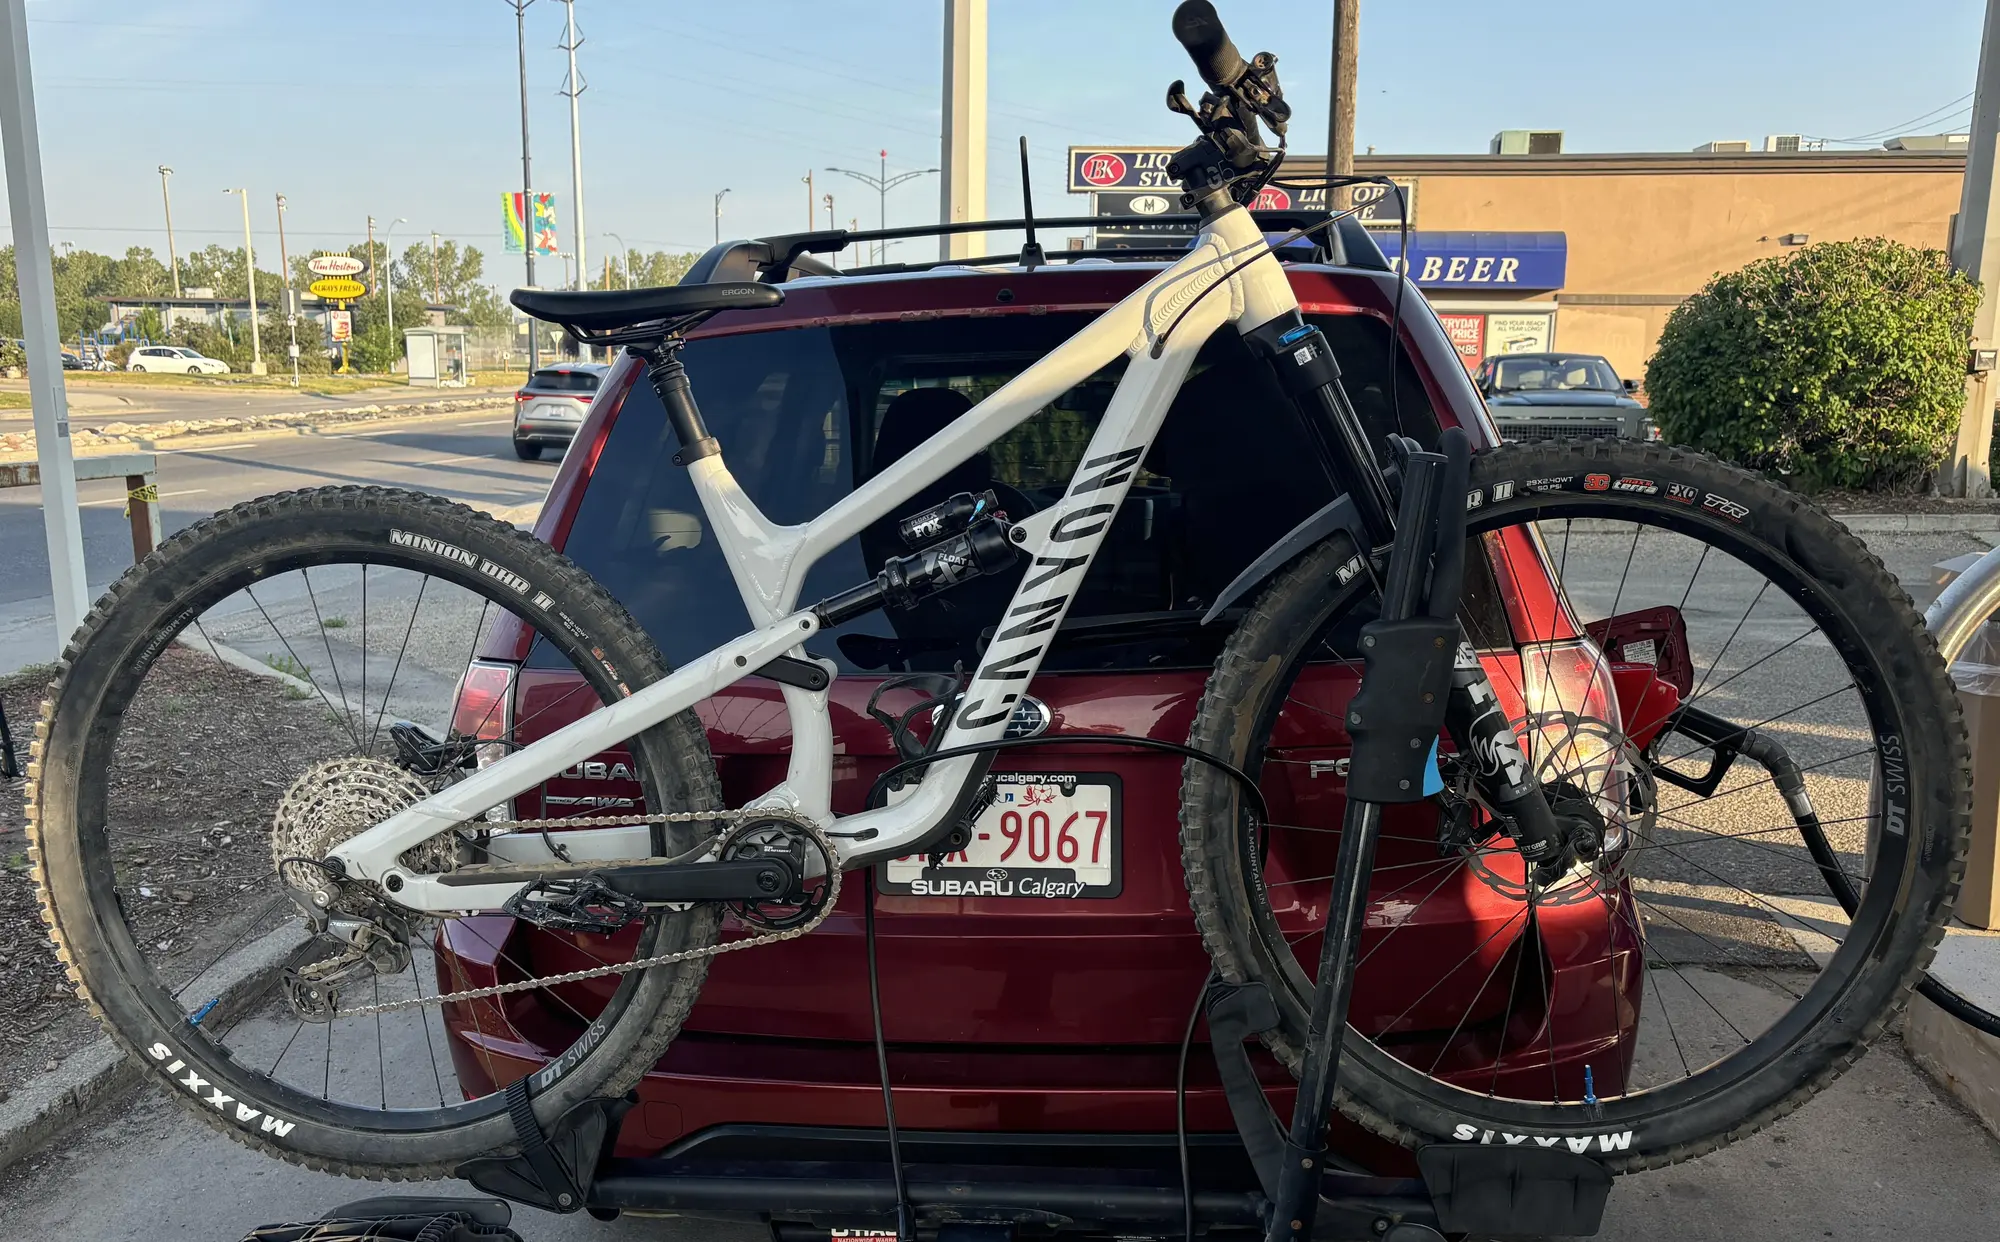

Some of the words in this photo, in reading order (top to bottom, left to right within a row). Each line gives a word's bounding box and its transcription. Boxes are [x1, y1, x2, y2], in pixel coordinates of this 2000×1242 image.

[1087, 157, 1117, 180] BK
[1133, 154, 1171, 171] LIQ
[1138, 172, 1181, 187] STO
[1298, 188, 1385, 202] LIOR
[312, 260, 328, 270] Tim
[329, 259, 360, 271] Hortons
[1418, 257, 1519, 283] BEER
[340, 284, 361, 292] FRESH
[721, 288, 755, 296] ERGON
[1441, 318, 1480, 329] ERYDAY
[1451, 328, 1479, 339] PRICE
[1526, 476, 1574, 487] 29X2.40WT
[1584, 473, 1611, 491] 3C
[1612, 480, 1658, 495] terra
[1492, 480, 1515, 502] II
[1669, 483, 1698, 499] EXO
[1703, 492, 1749, 519] TR
[911, 514, 931, 526] FLOAT
[913, 518, 943, 537] FOX
[938, 552, 967, 565] FLOAT
[390, 529, 479, 569] MINION
[479, 558, 531, 595] DHR
[532, 590, 556, 612] II
[956, 445, 1147, 731] CANYON
[552, 761, 640, 781] UBA
[1880, 735, 1906, 795] SWISS
[574, 796, 634, 808] AWD
[1886, 799, 1906, 836] DT
[894, 811, 1108, 863] -9067
[1531, 839, 1547, 850] GRIP
[1248, 836, 1263, 891] MOUNTAIN
[911, 880, 1013, 896] SUBARU
[1018, 877, 1085, 899] Calgary
[541, 1059, 564, 1089] DT
[567, 1019, 606, 1067] SWISS
[147, 1042, 297, 1138] MAXXIS
